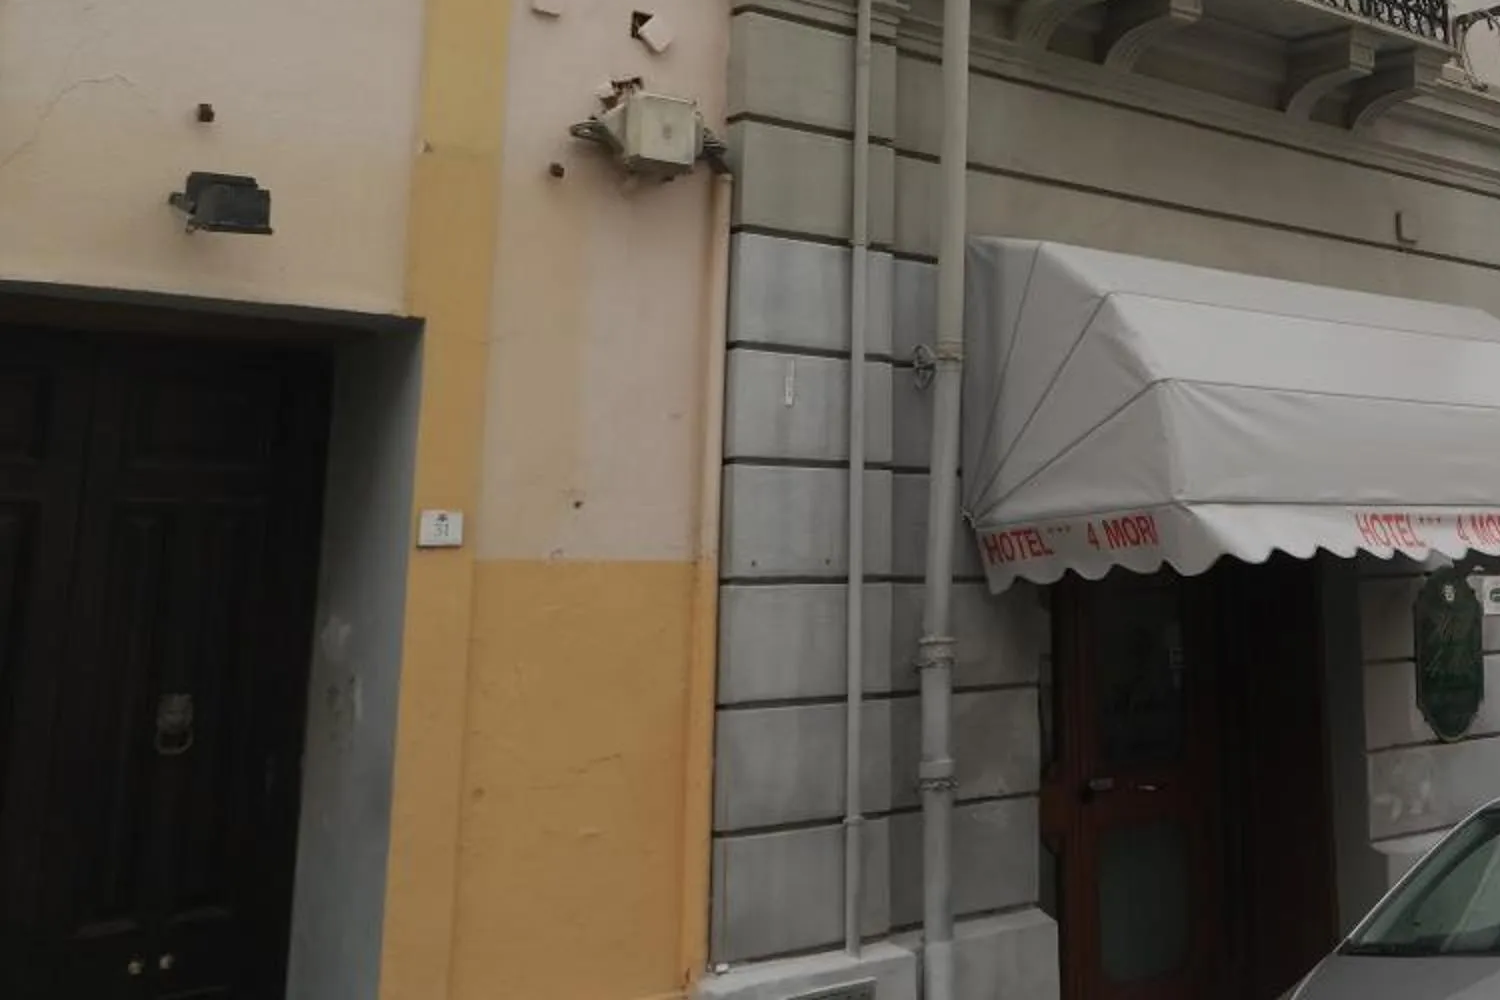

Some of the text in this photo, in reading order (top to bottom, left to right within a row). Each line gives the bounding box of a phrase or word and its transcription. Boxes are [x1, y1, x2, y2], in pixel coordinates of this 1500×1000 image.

[982, 514, 1160, 566] HOTEL 4 MORI
[1354, 513, 1427, 548] HOTEL
